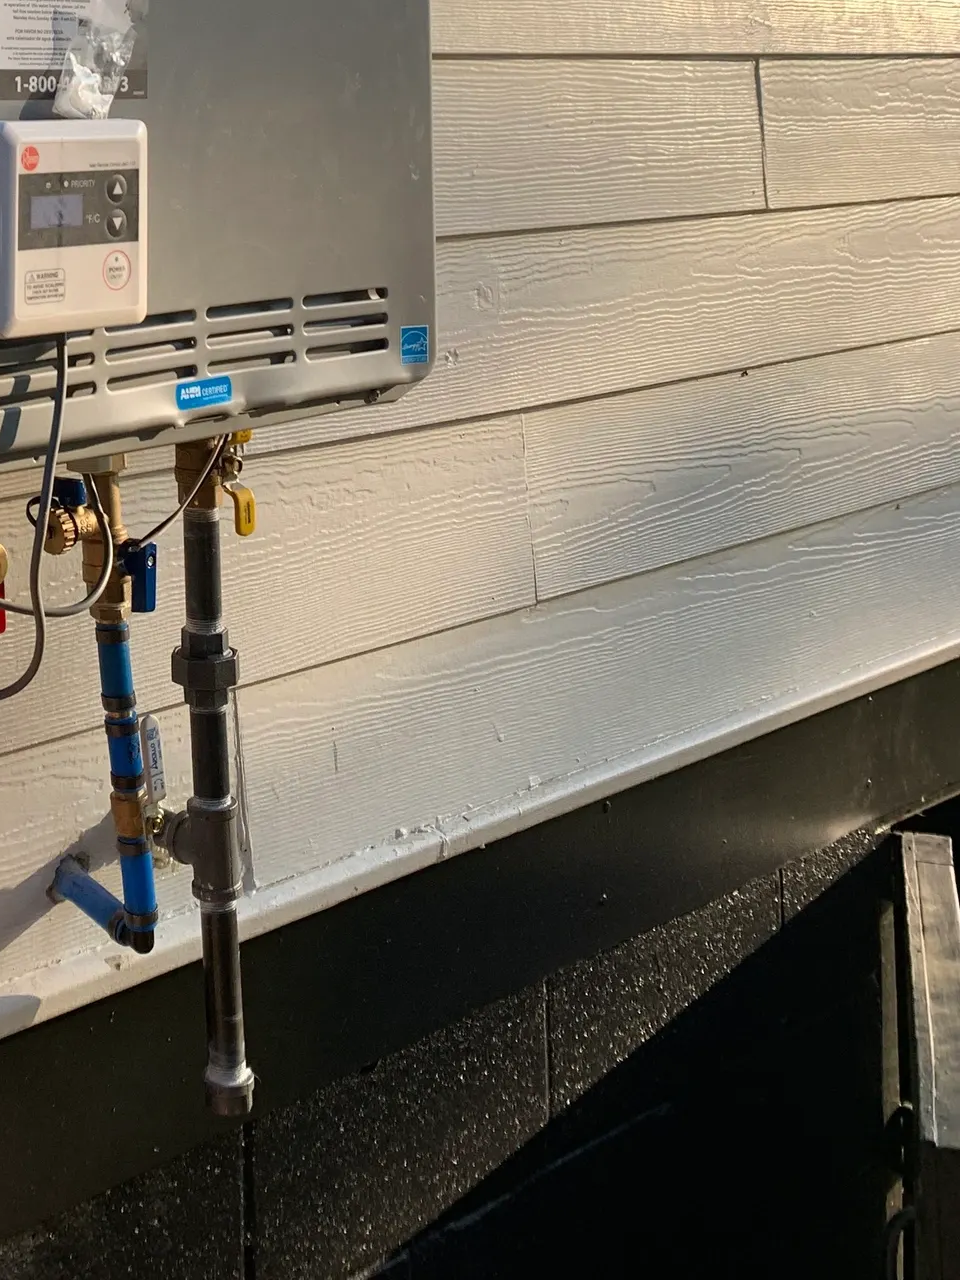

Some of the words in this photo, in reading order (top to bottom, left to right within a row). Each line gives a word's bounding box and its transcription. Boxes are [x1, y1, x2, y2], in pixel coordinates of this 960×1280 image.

[70, 179, 96, 189] PRIORITY
[36, 271, 59, 280] WARNING
[201, 384, 228, 397] CERTIFIED
